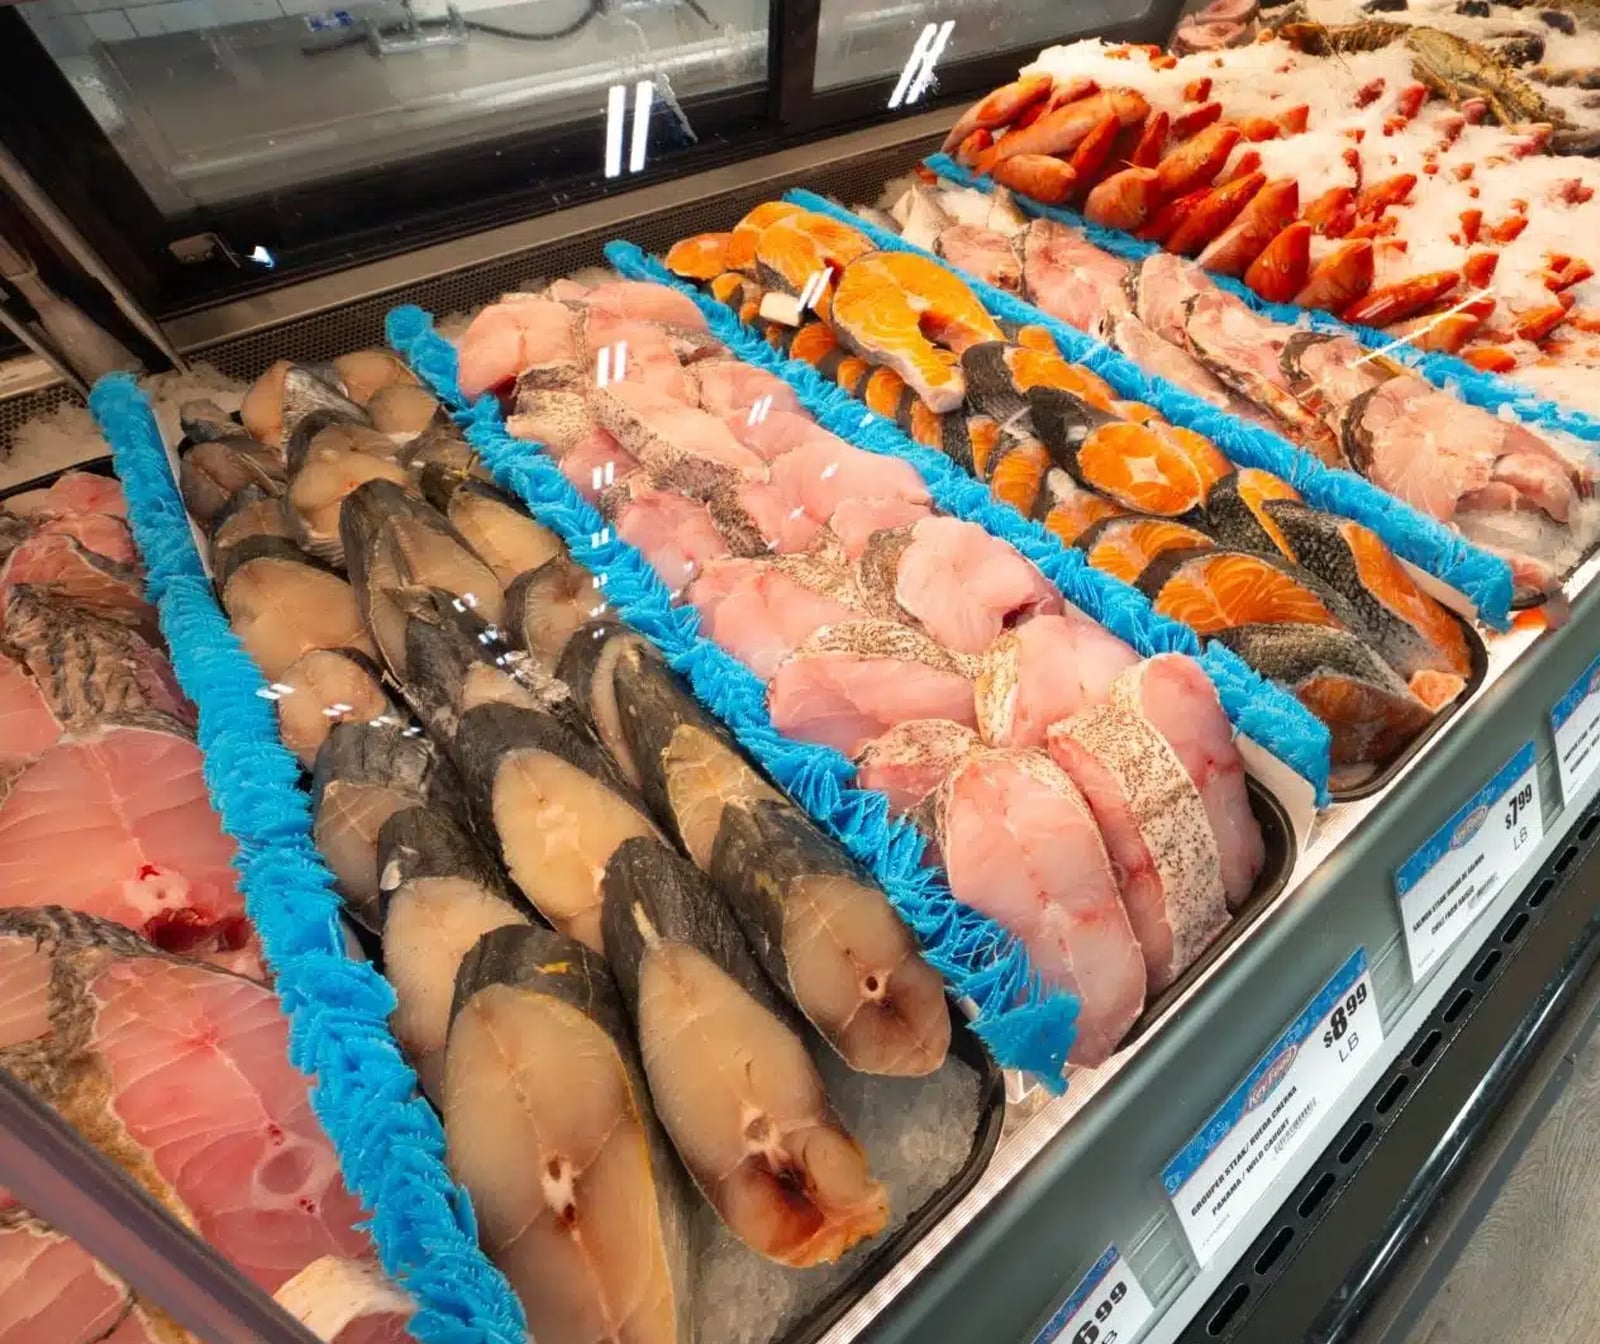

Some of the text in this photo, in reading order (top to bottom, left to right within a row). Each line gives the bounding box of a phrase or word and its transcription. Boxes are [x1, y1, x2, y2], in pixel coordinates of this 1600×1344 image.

[1513, 826, 1528, 850] LB
[1338, 1032, 1359, 1063] LB
[1191, 1174, 1225, 1216] GROUPER
[1249, 1117, 1272, 1146] RUEDA
[1212, 1178, 1242, 1216] PANAMA
[1246, 1150, 1264, 1174] WILD
[1264, 1118, 1290, 1151] CAUGHT
